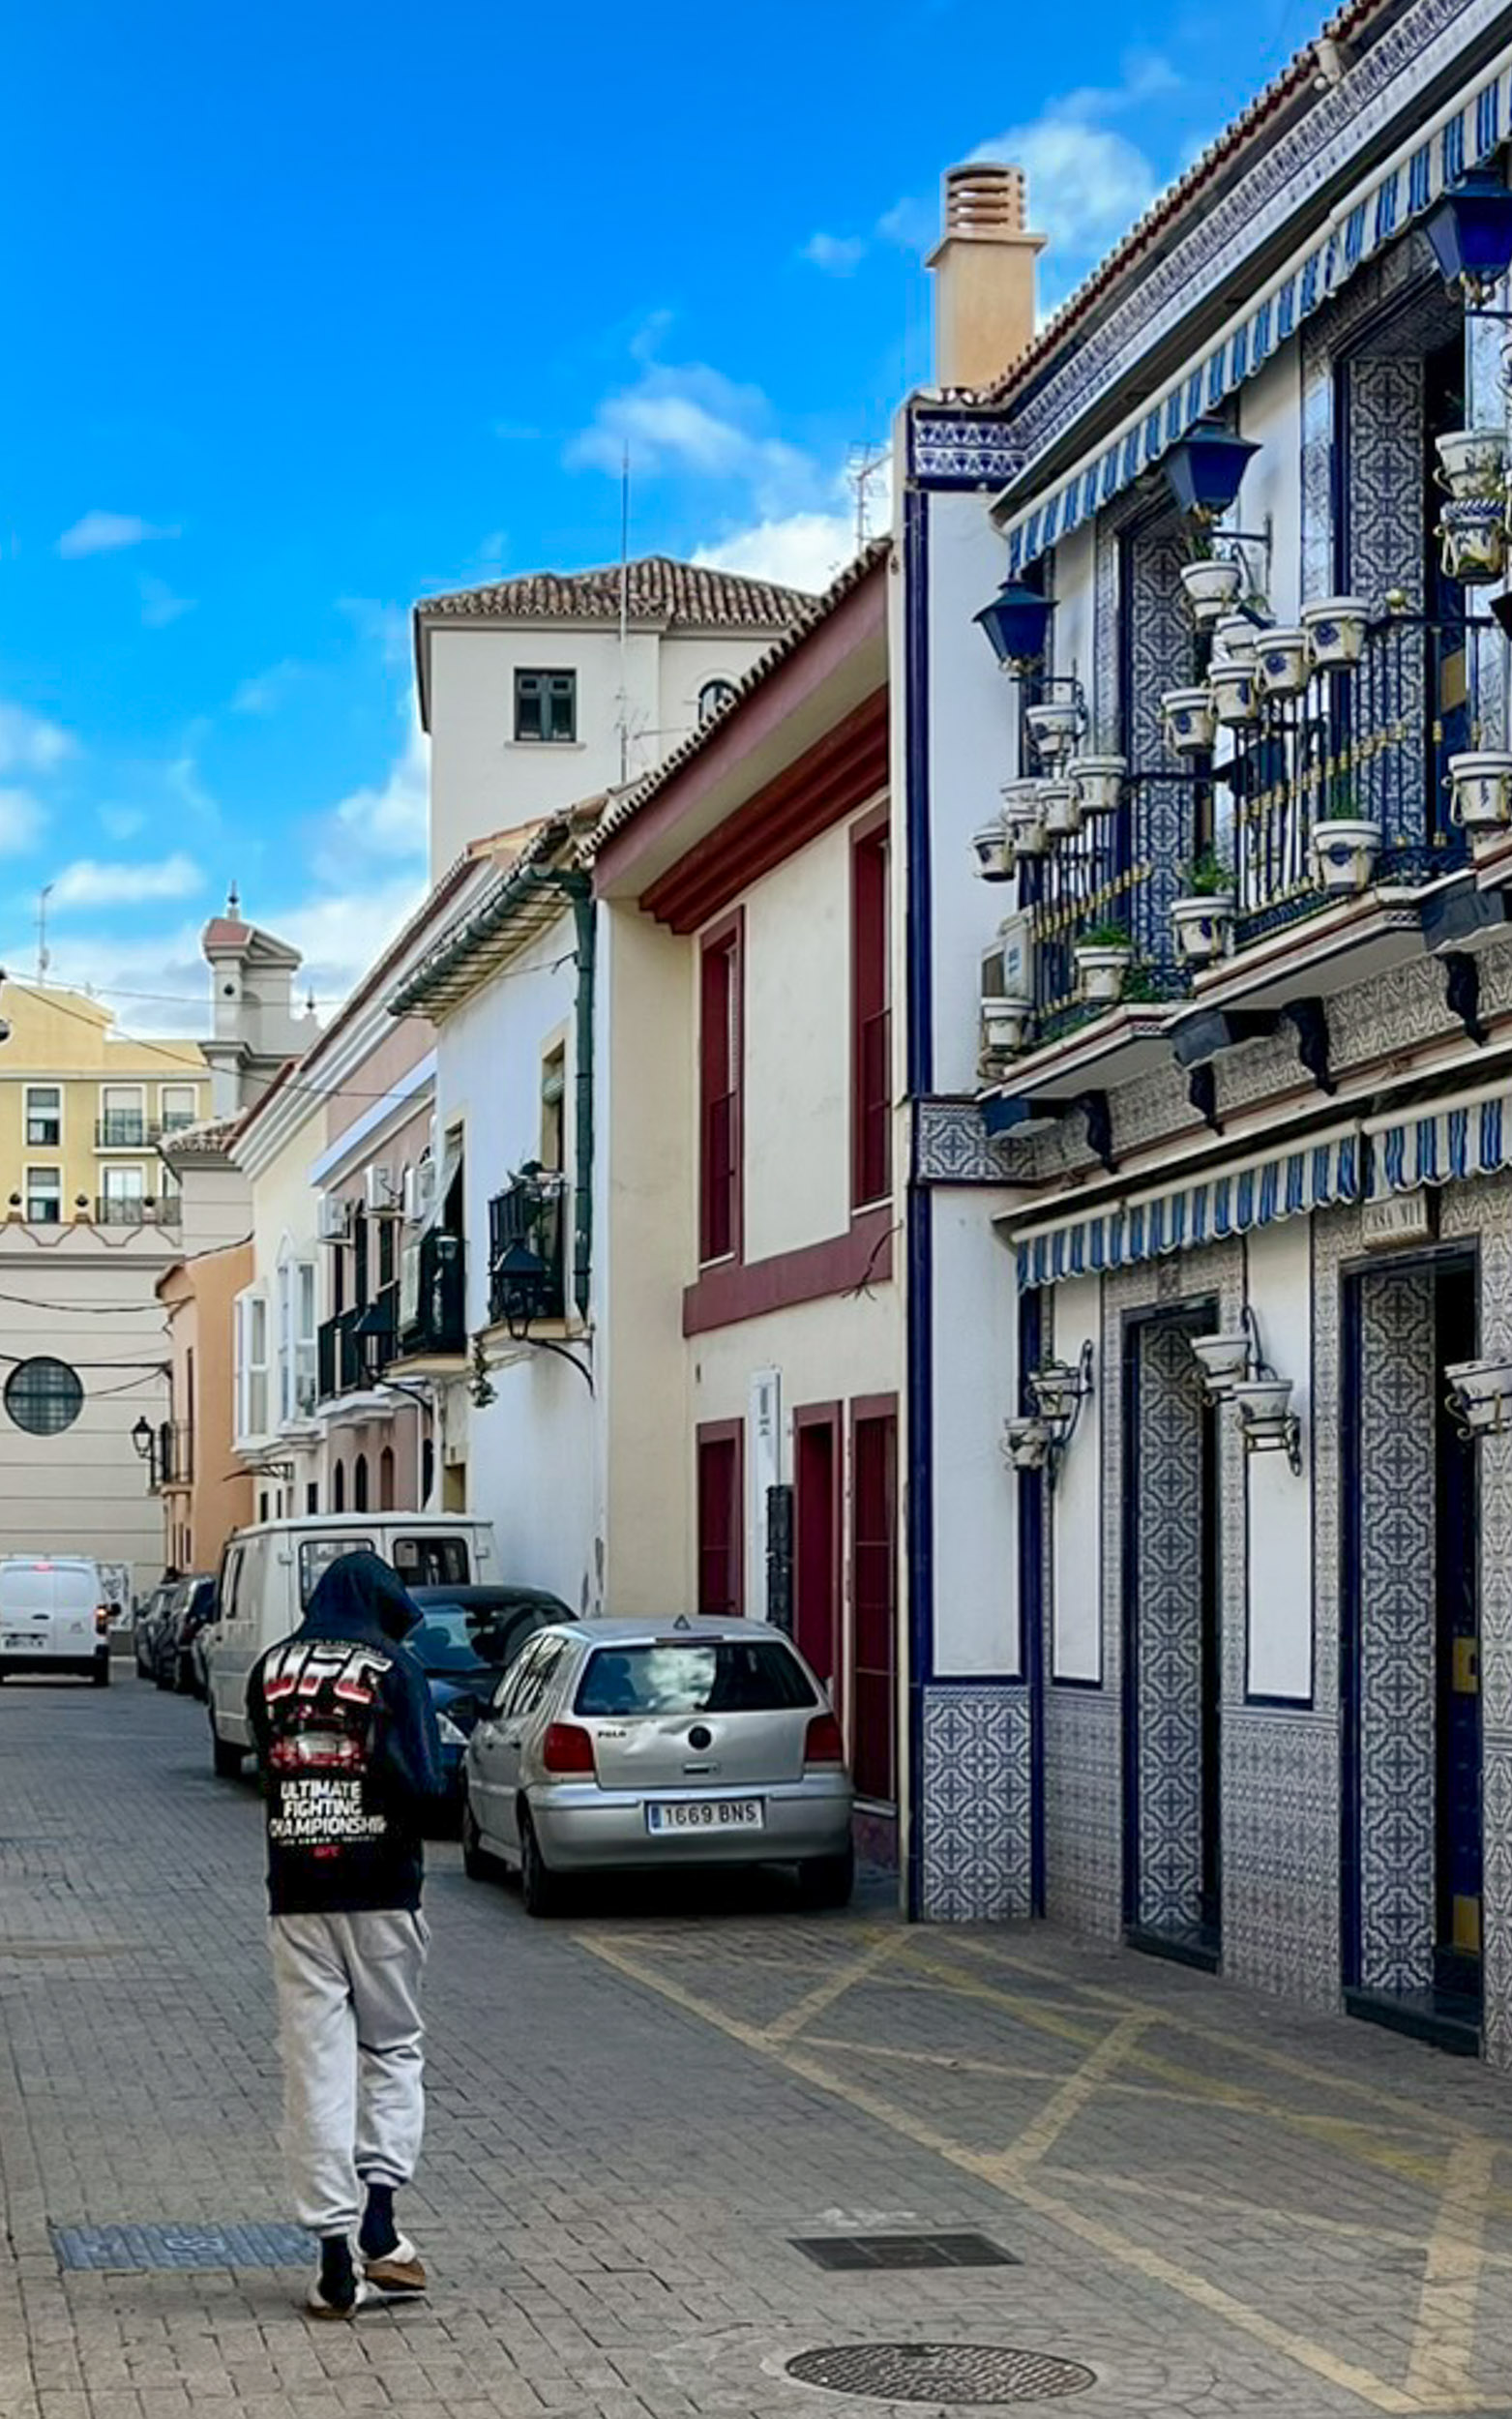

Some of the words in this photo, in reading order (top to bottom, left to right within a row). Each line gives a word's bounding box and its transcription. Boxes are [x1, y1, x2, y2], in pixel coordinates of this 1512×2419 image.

[263, 1645, 393, 1703] UFC
[281, 1779, 362, 1799] ULTIMATE
[283, 1799, 362, 1816] FIGHTING
[666, 1806, 713, 1826] 1669
[720, 1804, 756, 1823] BNS
[270, 1815, 387, 1837] CHAMPIONSHIP
